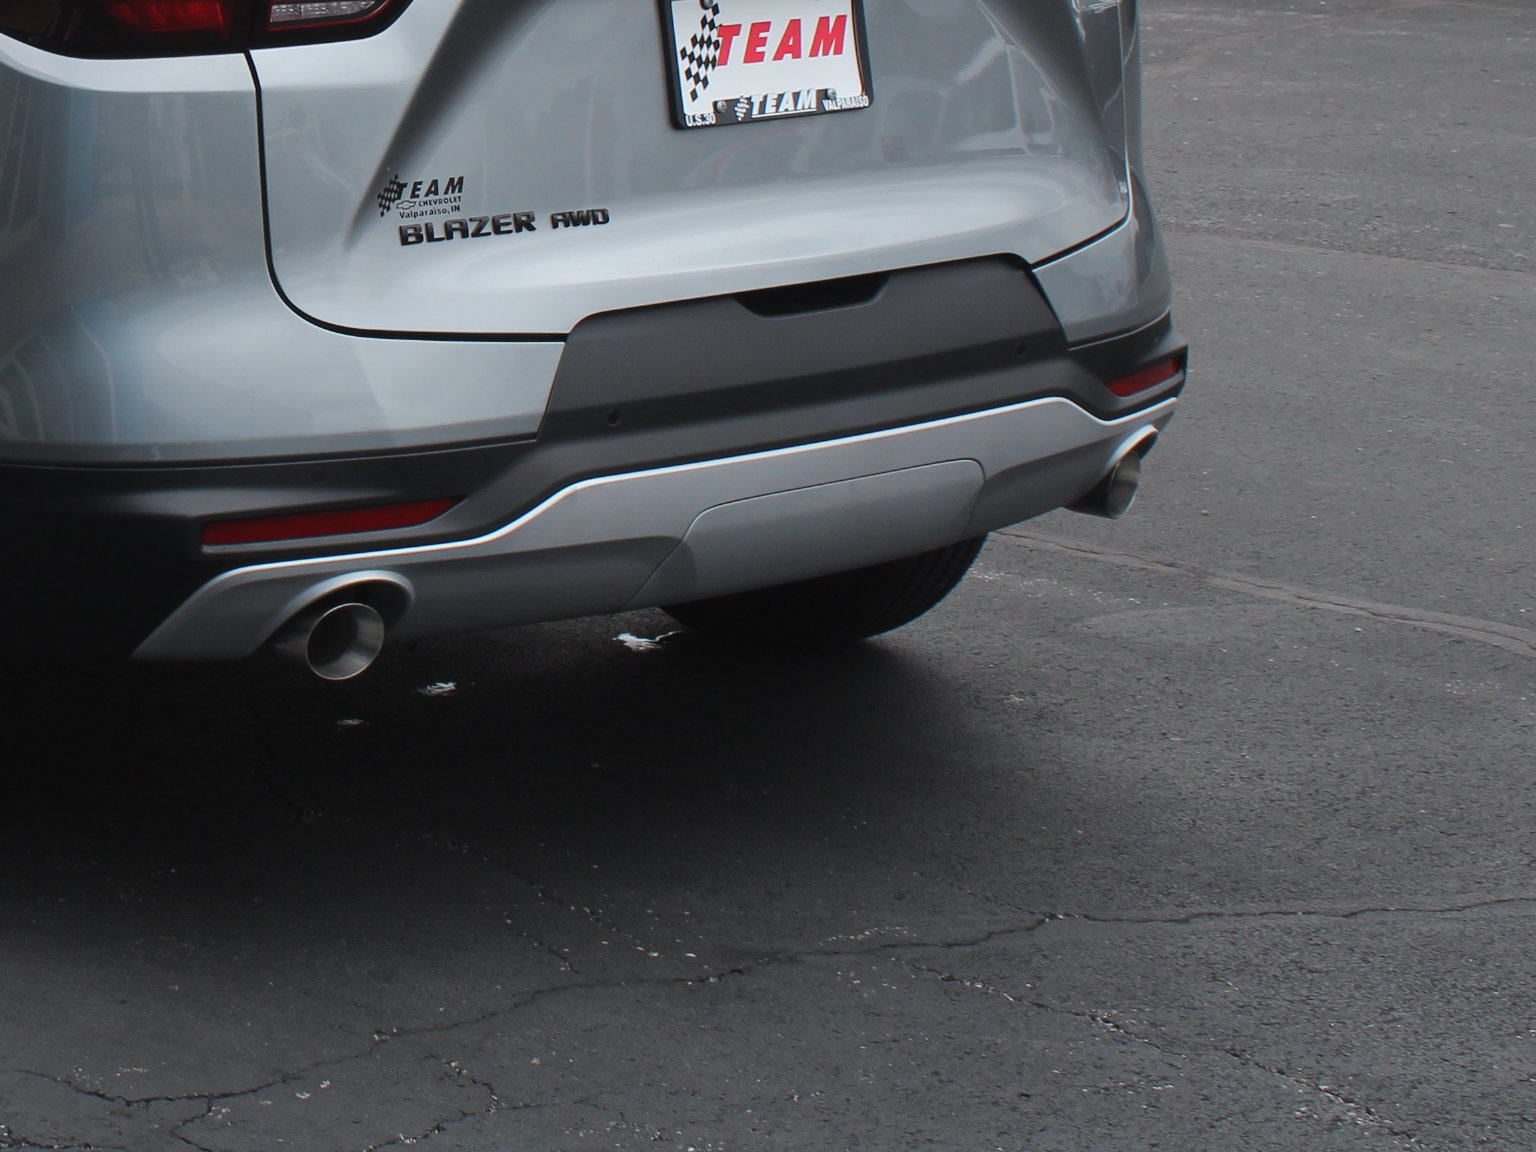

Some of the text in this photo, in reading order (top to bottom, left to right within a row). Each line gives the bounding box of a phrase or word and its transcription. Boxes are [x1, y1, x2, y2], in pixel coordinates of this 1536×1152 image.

[717, 14, 848, 66] TEAM
[750, 89, 816, 115] TEAM
[822, 95, 869, 111] VALPARAISO
[396, 176, 464, 200] TEAM
[418, 196, 461, 207] CHEVROLET
[399, 208, 610, 246] BLAZER AWD
